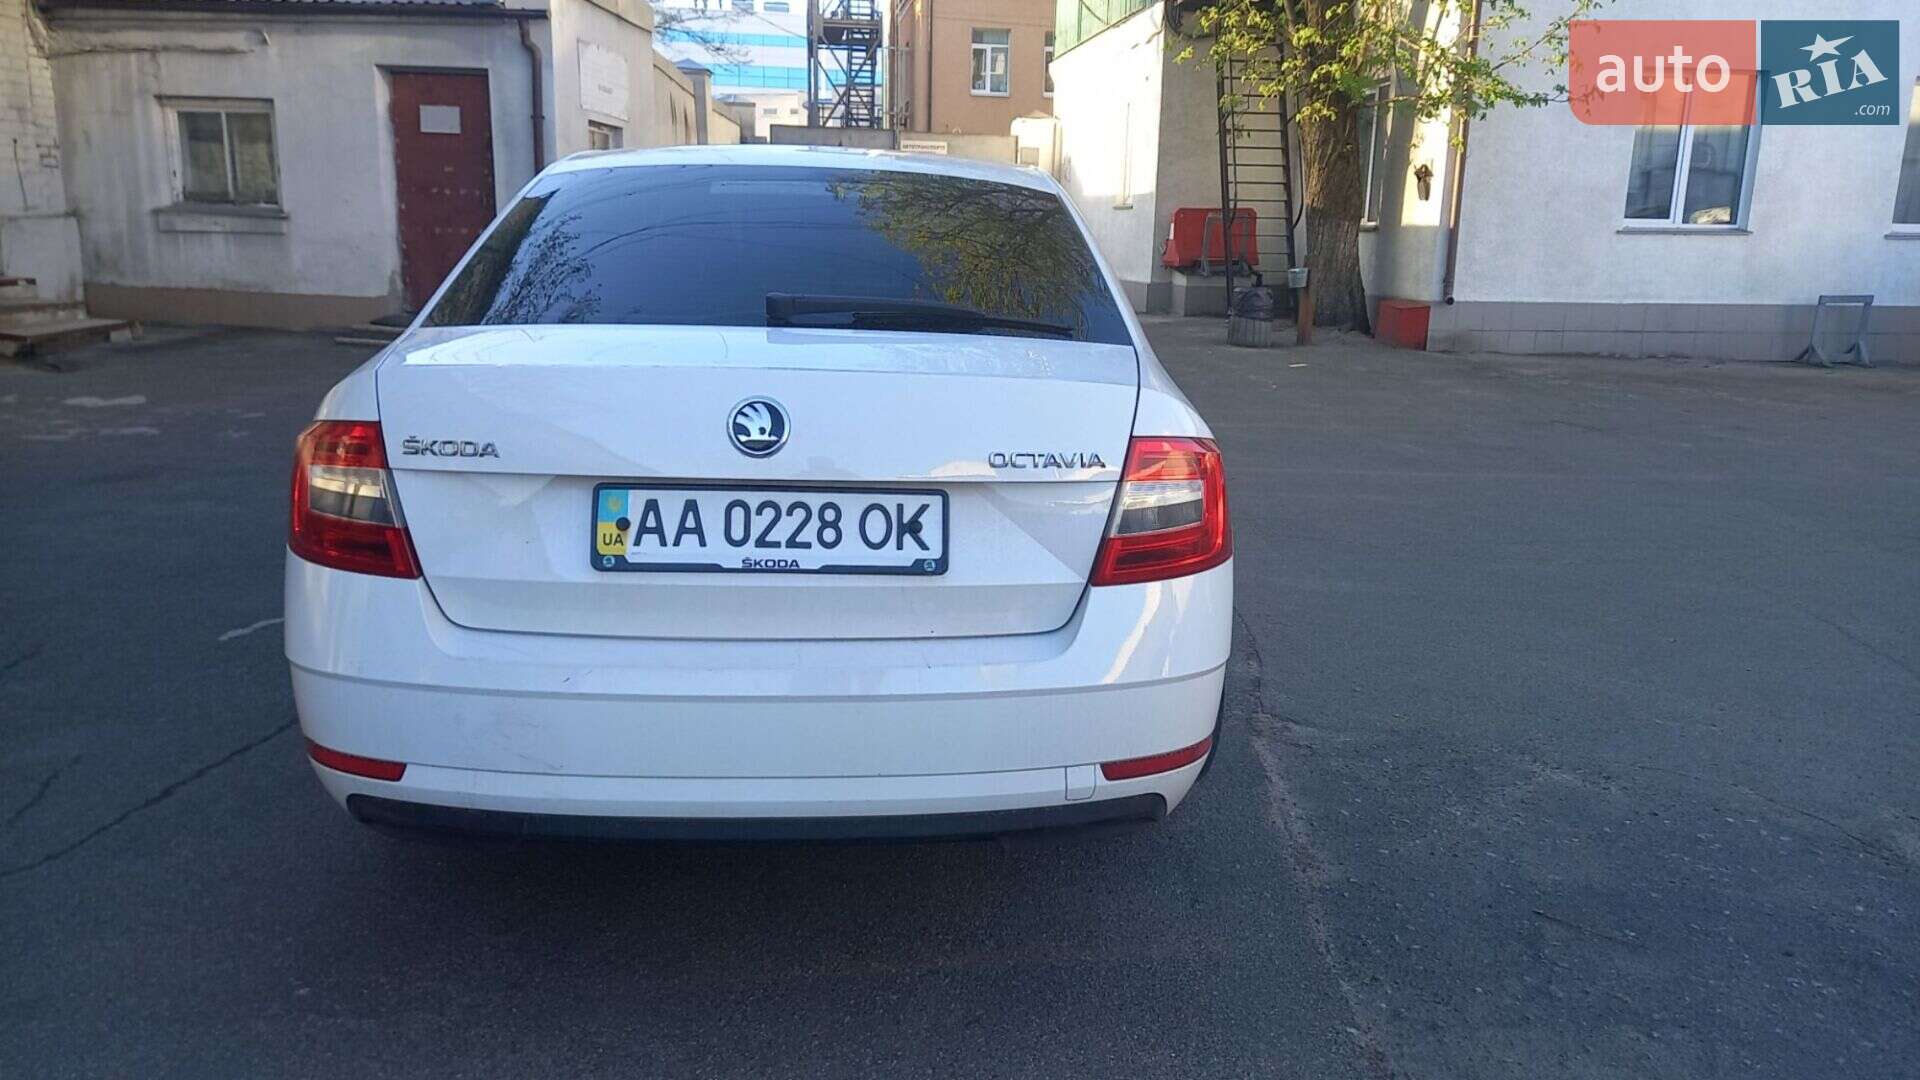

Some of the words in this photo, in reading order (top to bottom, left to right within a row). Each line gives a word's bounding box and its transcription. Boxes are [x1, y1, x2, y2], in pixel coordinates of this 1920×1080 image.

[402, 435, 500, 458] ŠKODA
[988, 452, 1106, 469] OCTAVIA
[633, 498, 707, 547] AA
[724, 499, 842, 549] 0228
[858, 502, 930, 551] OK
[602, 533, 624, 546] UA
[741, 557, 800, 569] ŠKODA
